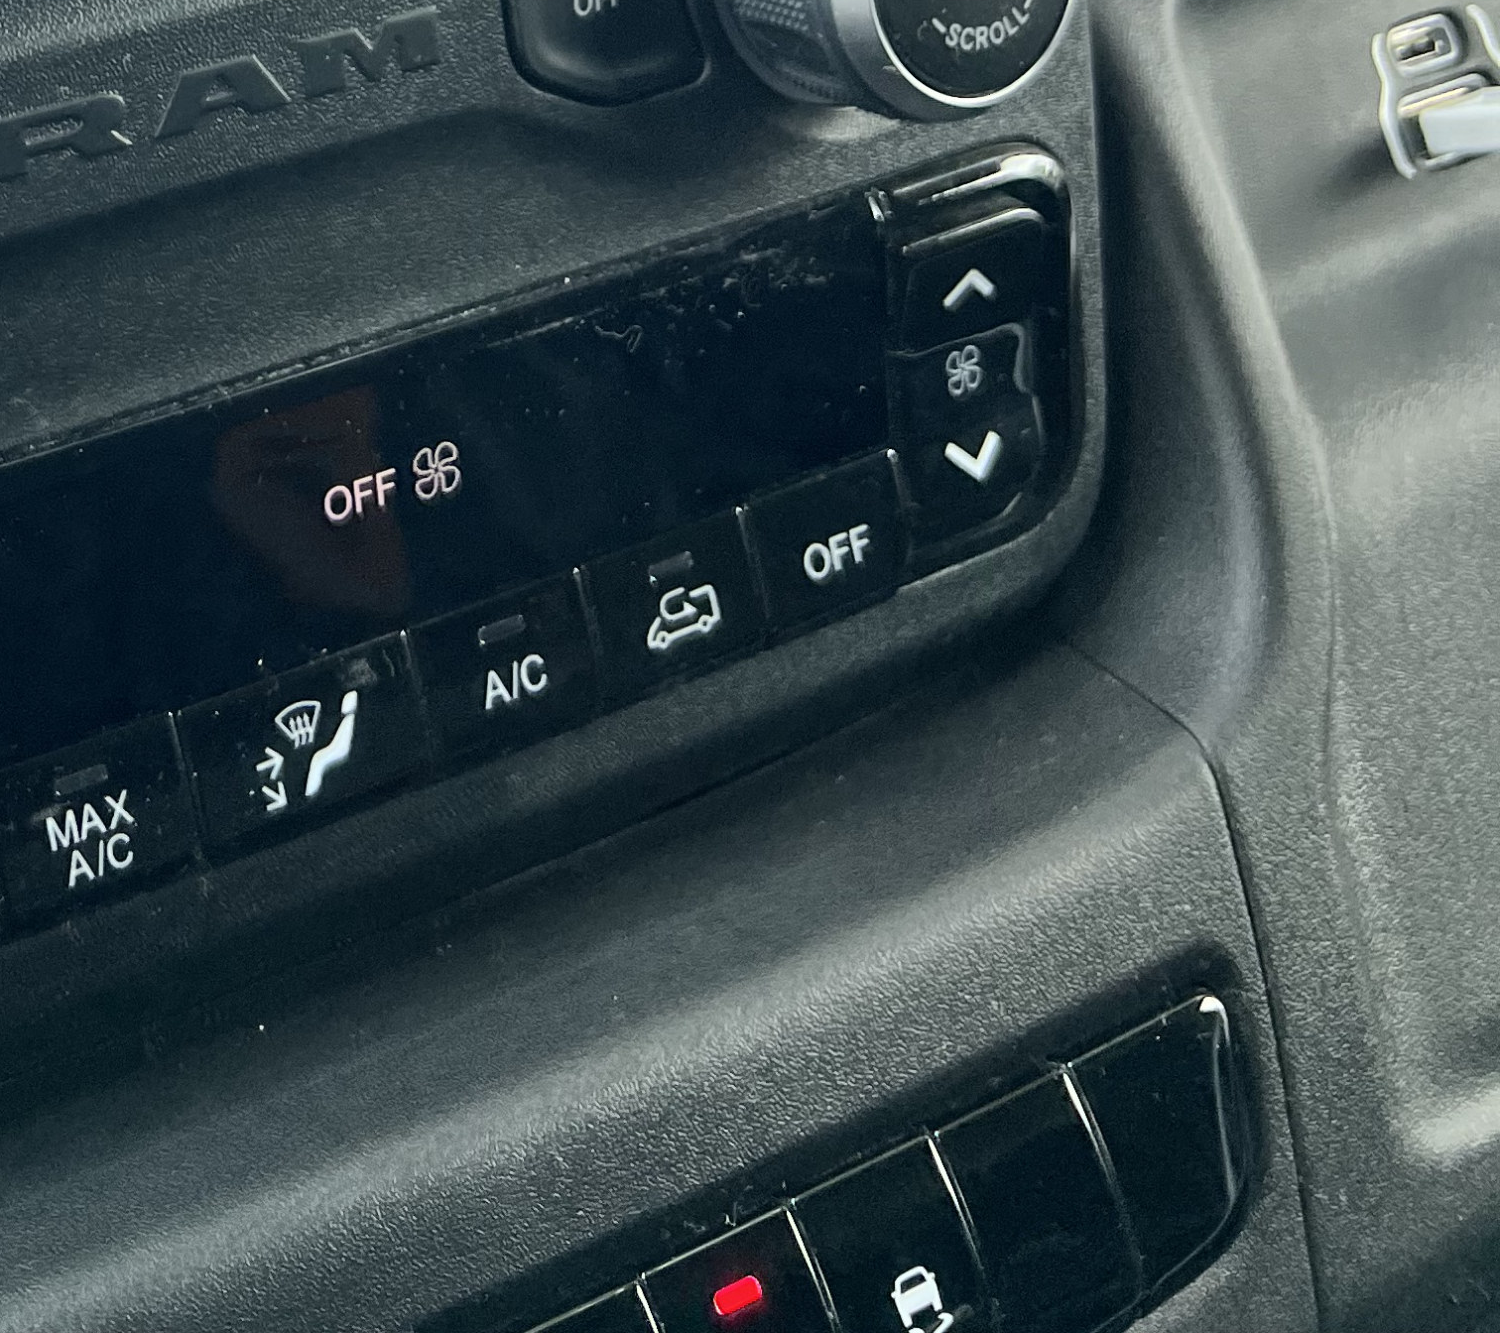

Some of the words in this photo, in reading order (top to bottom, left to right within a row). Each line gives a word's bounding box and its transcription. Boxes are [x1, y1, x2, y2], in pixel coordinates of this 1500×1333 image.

[944, 6, 1031, 52] SCROLL
[324, 468, 397, 524] OFF
[803, 523, 871, 582] OFF
[483, 654, 548, 710] A/C
[45, 789, 136, 853] MAX
[68, 834, 134, 888] A/C
